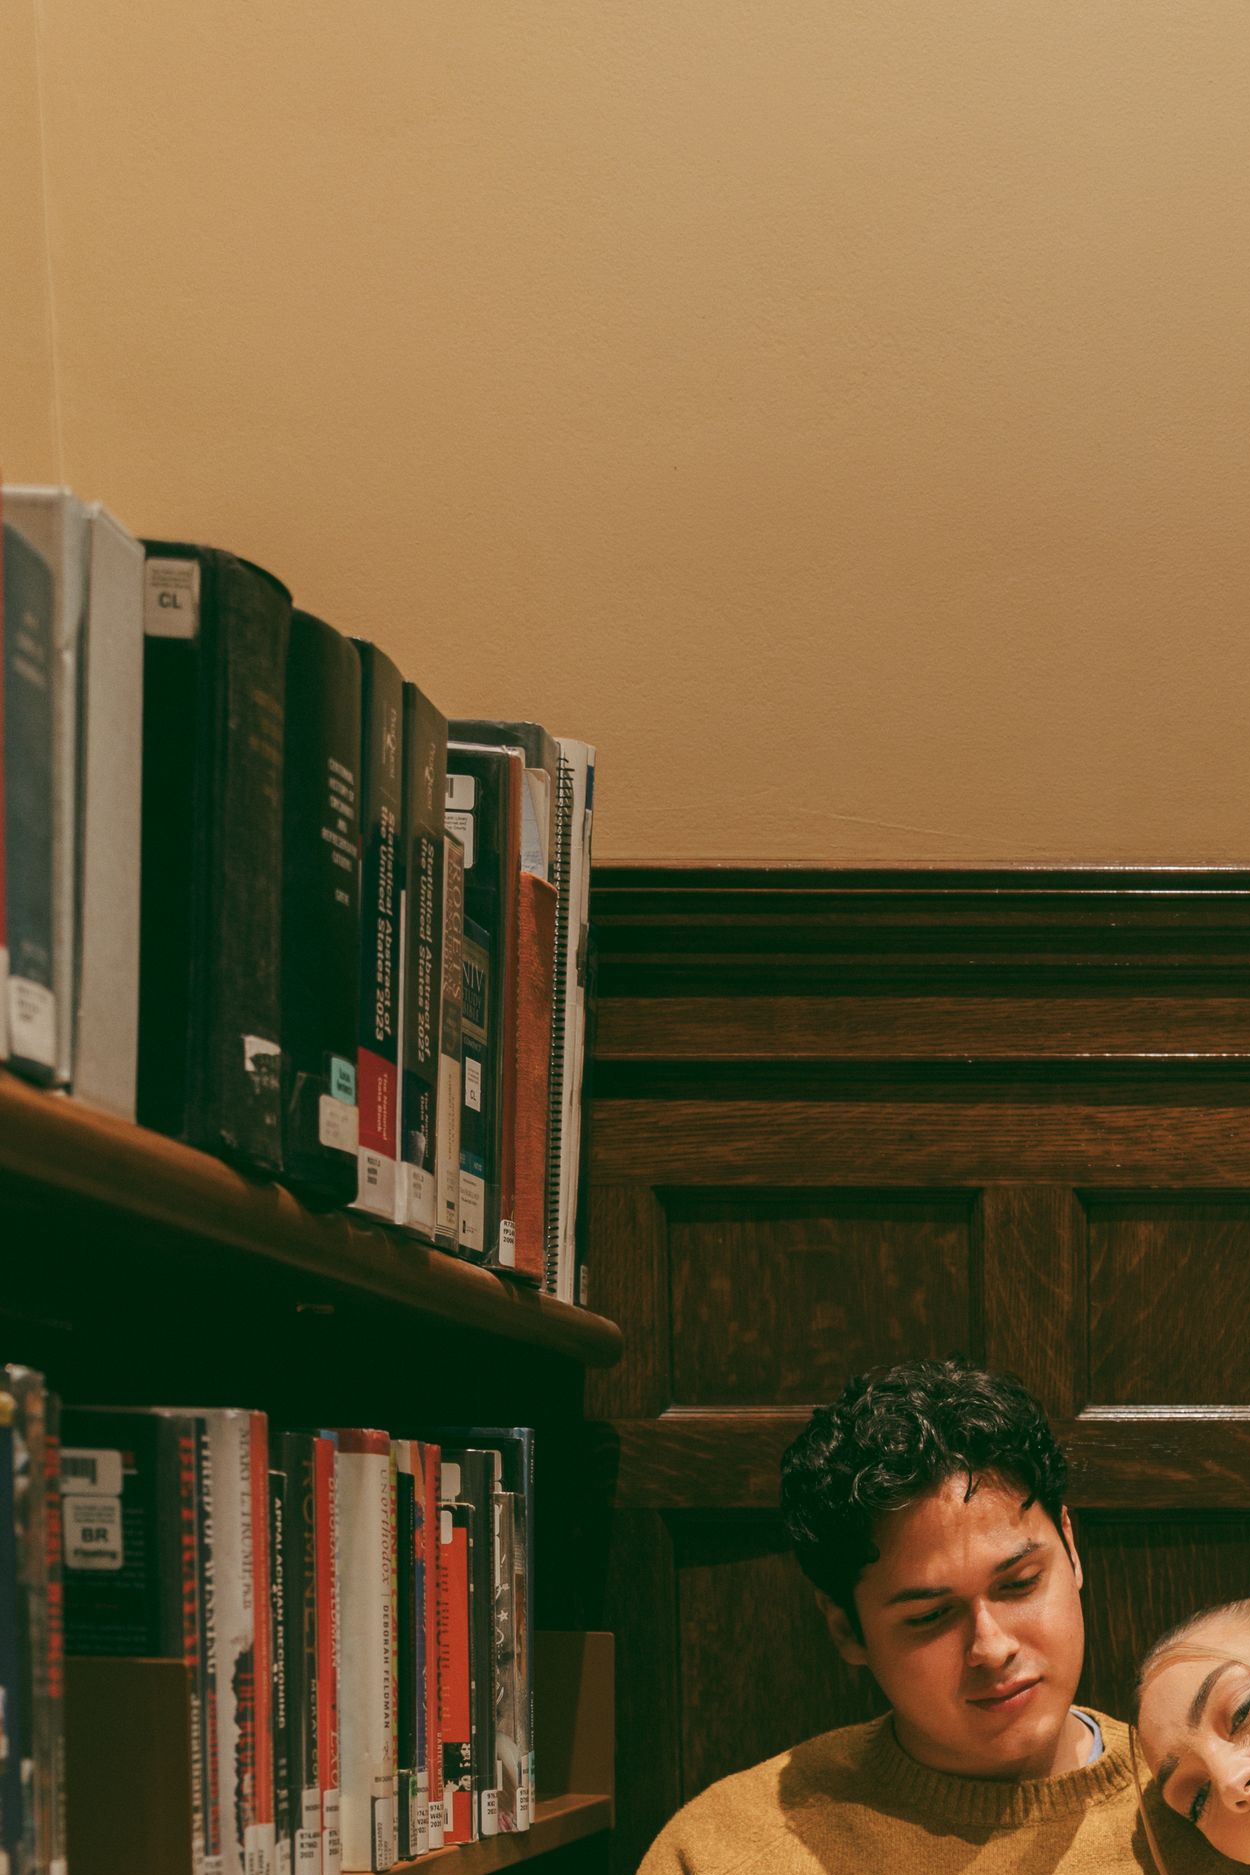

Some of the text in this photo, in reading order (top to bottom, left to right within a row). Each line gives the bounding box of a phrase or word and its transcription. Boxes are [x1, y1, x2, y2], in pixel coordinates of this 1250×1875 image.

[158, 590, 182, 609] CL
[374, 806, 389, 1042] the United States 2023
[383, 811, 396, 1036] Statistical Abstract of
[416, 837, 428, 1063] the United States 2022
[422, 842, 435, 1058] Statistical Abstract of
[239, 1427, 251, 1481] MARY
[81, 1528, 108, 1543] BR
[238, 1510, 254, 1581] TRUMP,
[274, 1496, 287, 1729] APPALACHIAN RECKONING
[383, 1669, 391, 1729] FELDMAN
